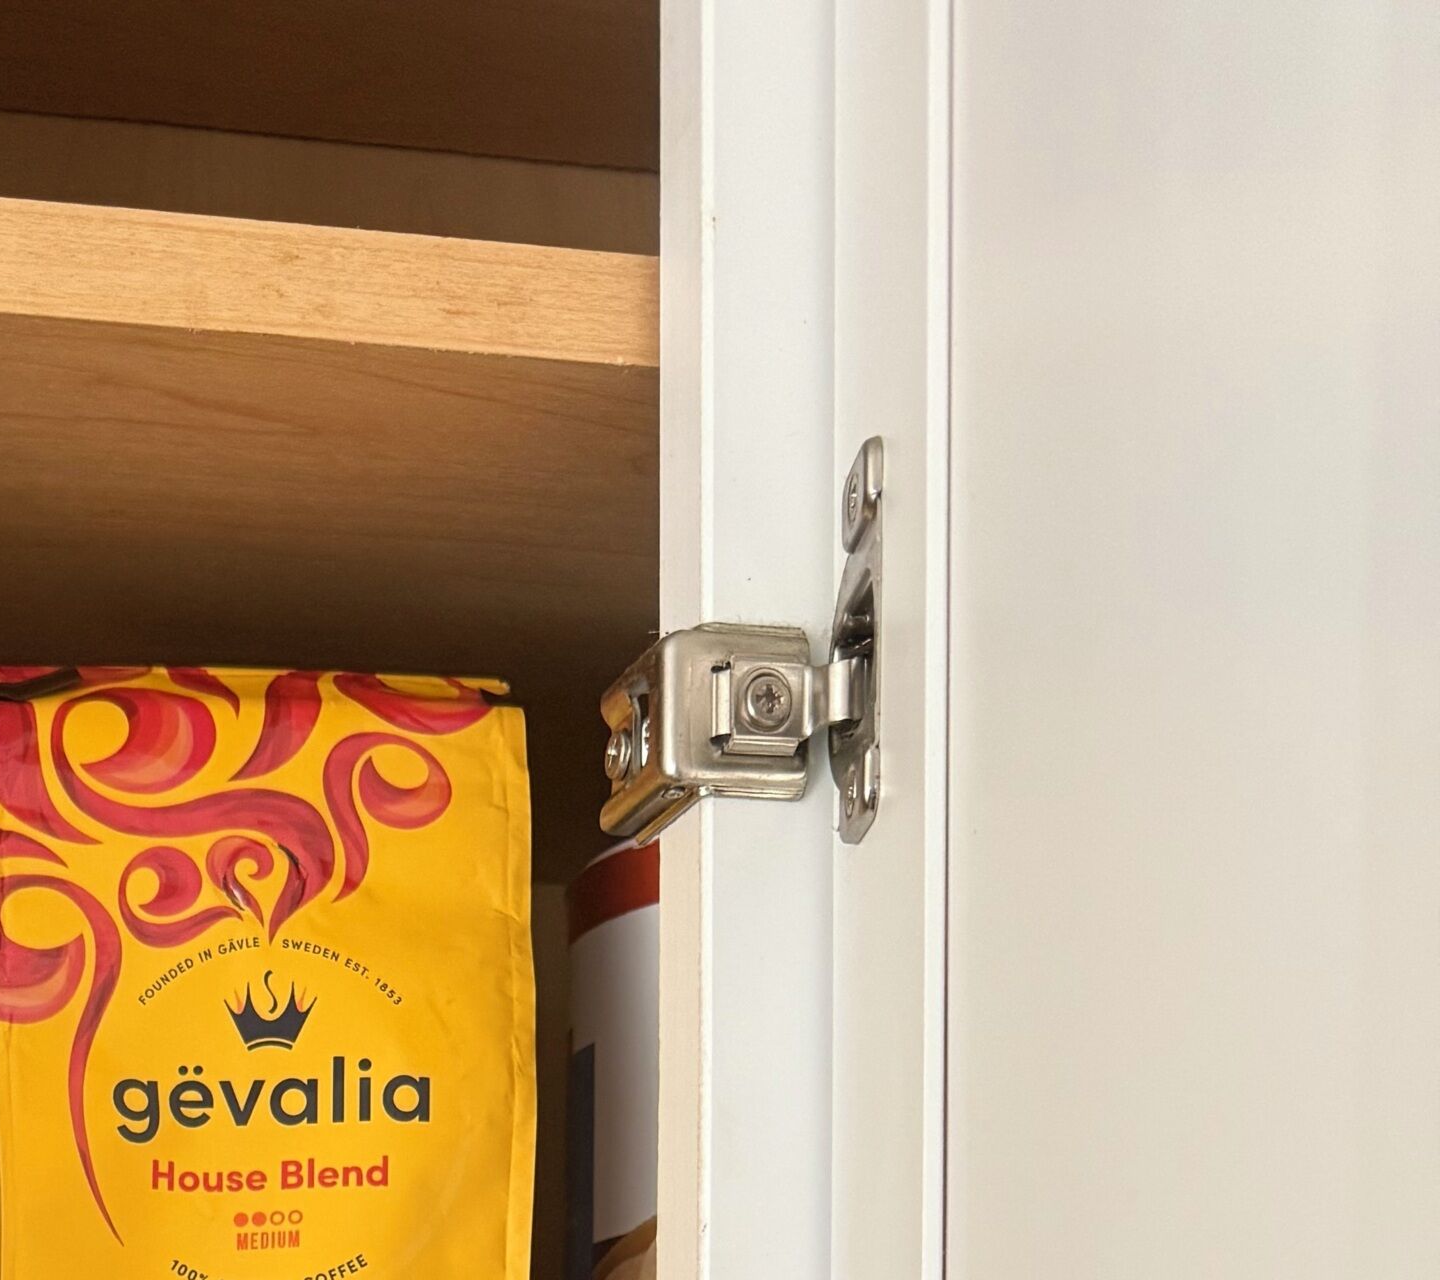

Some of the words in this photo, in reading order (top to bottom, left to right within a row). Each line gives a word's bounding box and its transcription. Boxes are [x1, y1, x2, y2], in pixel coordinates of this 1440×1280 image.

[138, 958, 194, 1006] FOUNDED
[198, 948, 213, 963] IN
[217, 936, 260, 955] GÄVLE
[282, 938, 340, 962] SWEDEN
[344, 957, 370, 980] EST.
[374, 977, 403, 1006] 1853
[112, 1055, 431, 1144] gëvalia
[151, 1158, 268, 1193] House
[280, 1154, 389, 1191] Blend
[236, 1229, 301, 1251] MEDIUM
